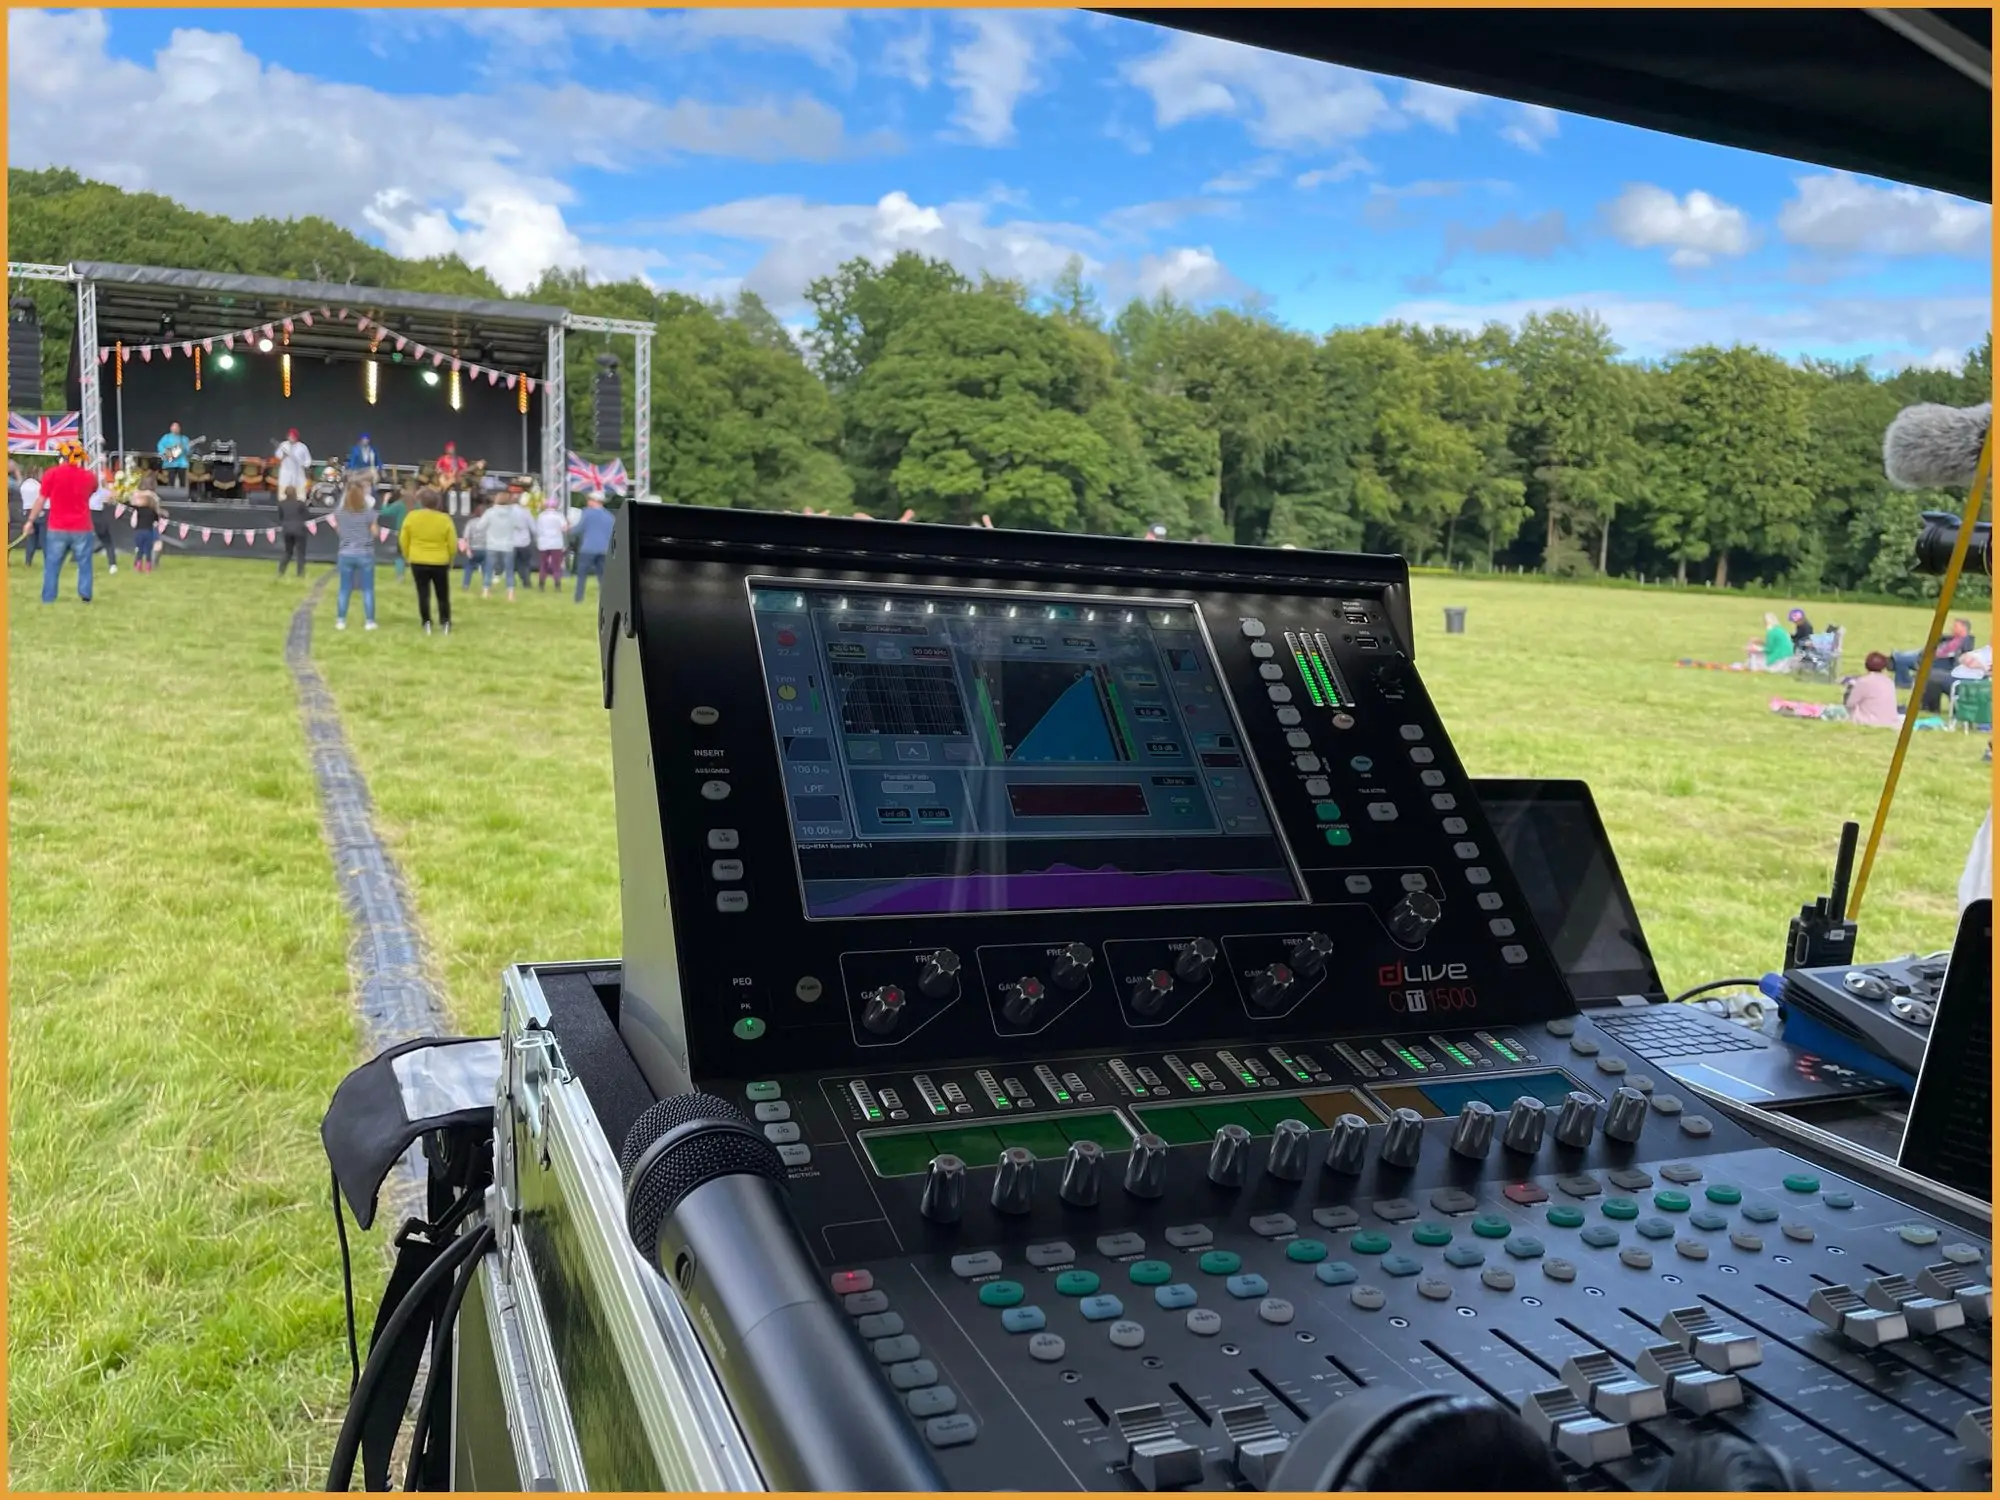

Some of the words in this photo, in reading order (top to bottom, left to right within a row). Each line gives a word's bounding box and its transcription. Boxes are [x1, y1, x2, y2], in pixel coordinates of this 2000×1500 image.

[793, 726, 815, 736] HPF
[694, 749, 725, 757] INSERT
[804, 783, 825, 793] LPF
[732, 976, 753, 987] PEQ
[740, 1001, 752, 1011] PK
